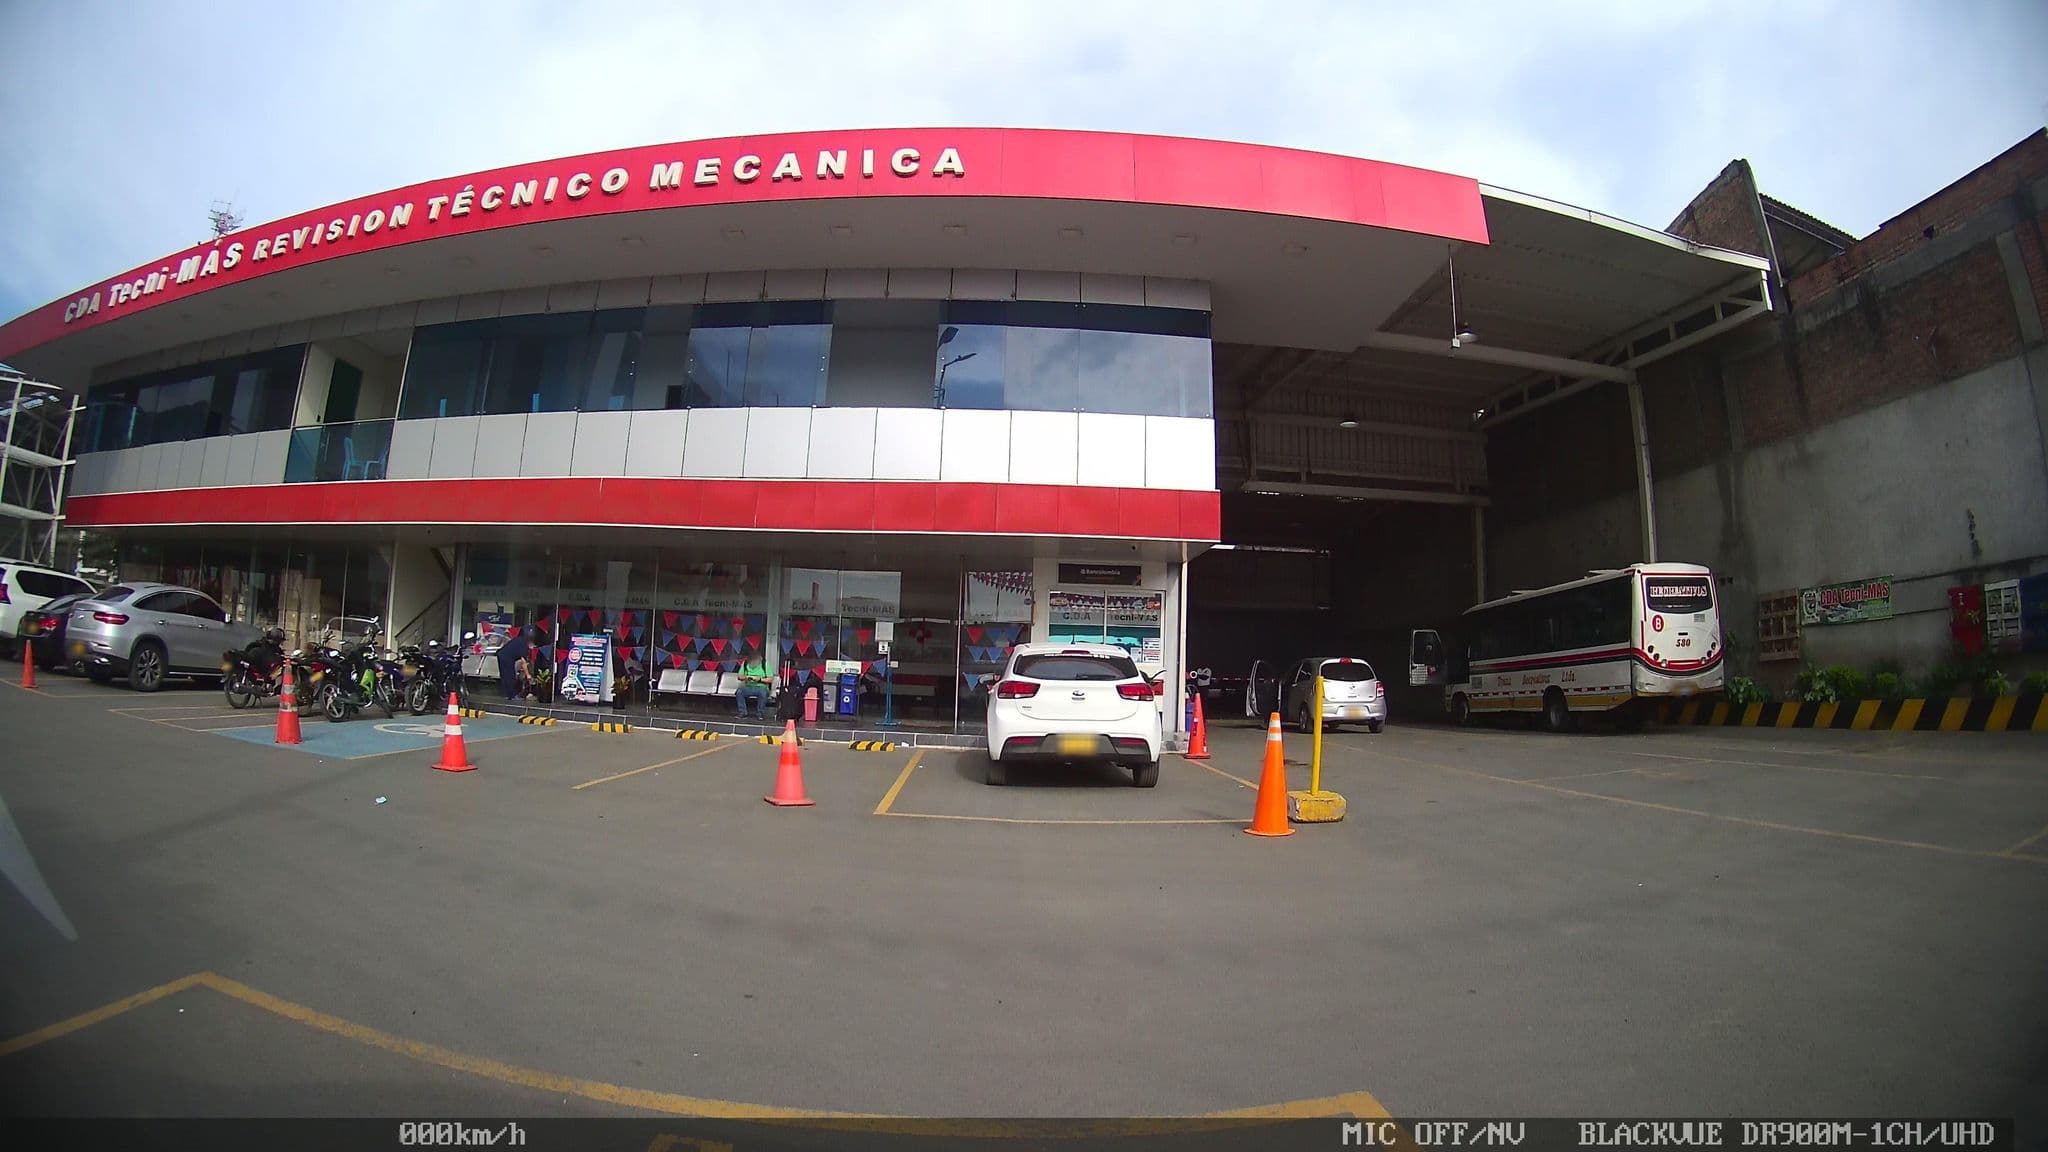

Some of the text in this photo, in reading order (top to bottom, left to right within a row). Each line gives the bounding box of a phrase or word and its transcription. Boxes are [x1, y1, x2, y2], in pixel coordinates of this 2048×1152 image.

[64, 147, 966, 323] CDA Tecni-MÁS REVISION TÉCNICO MECANICA
[1675, 639, 1691, 648] 580
